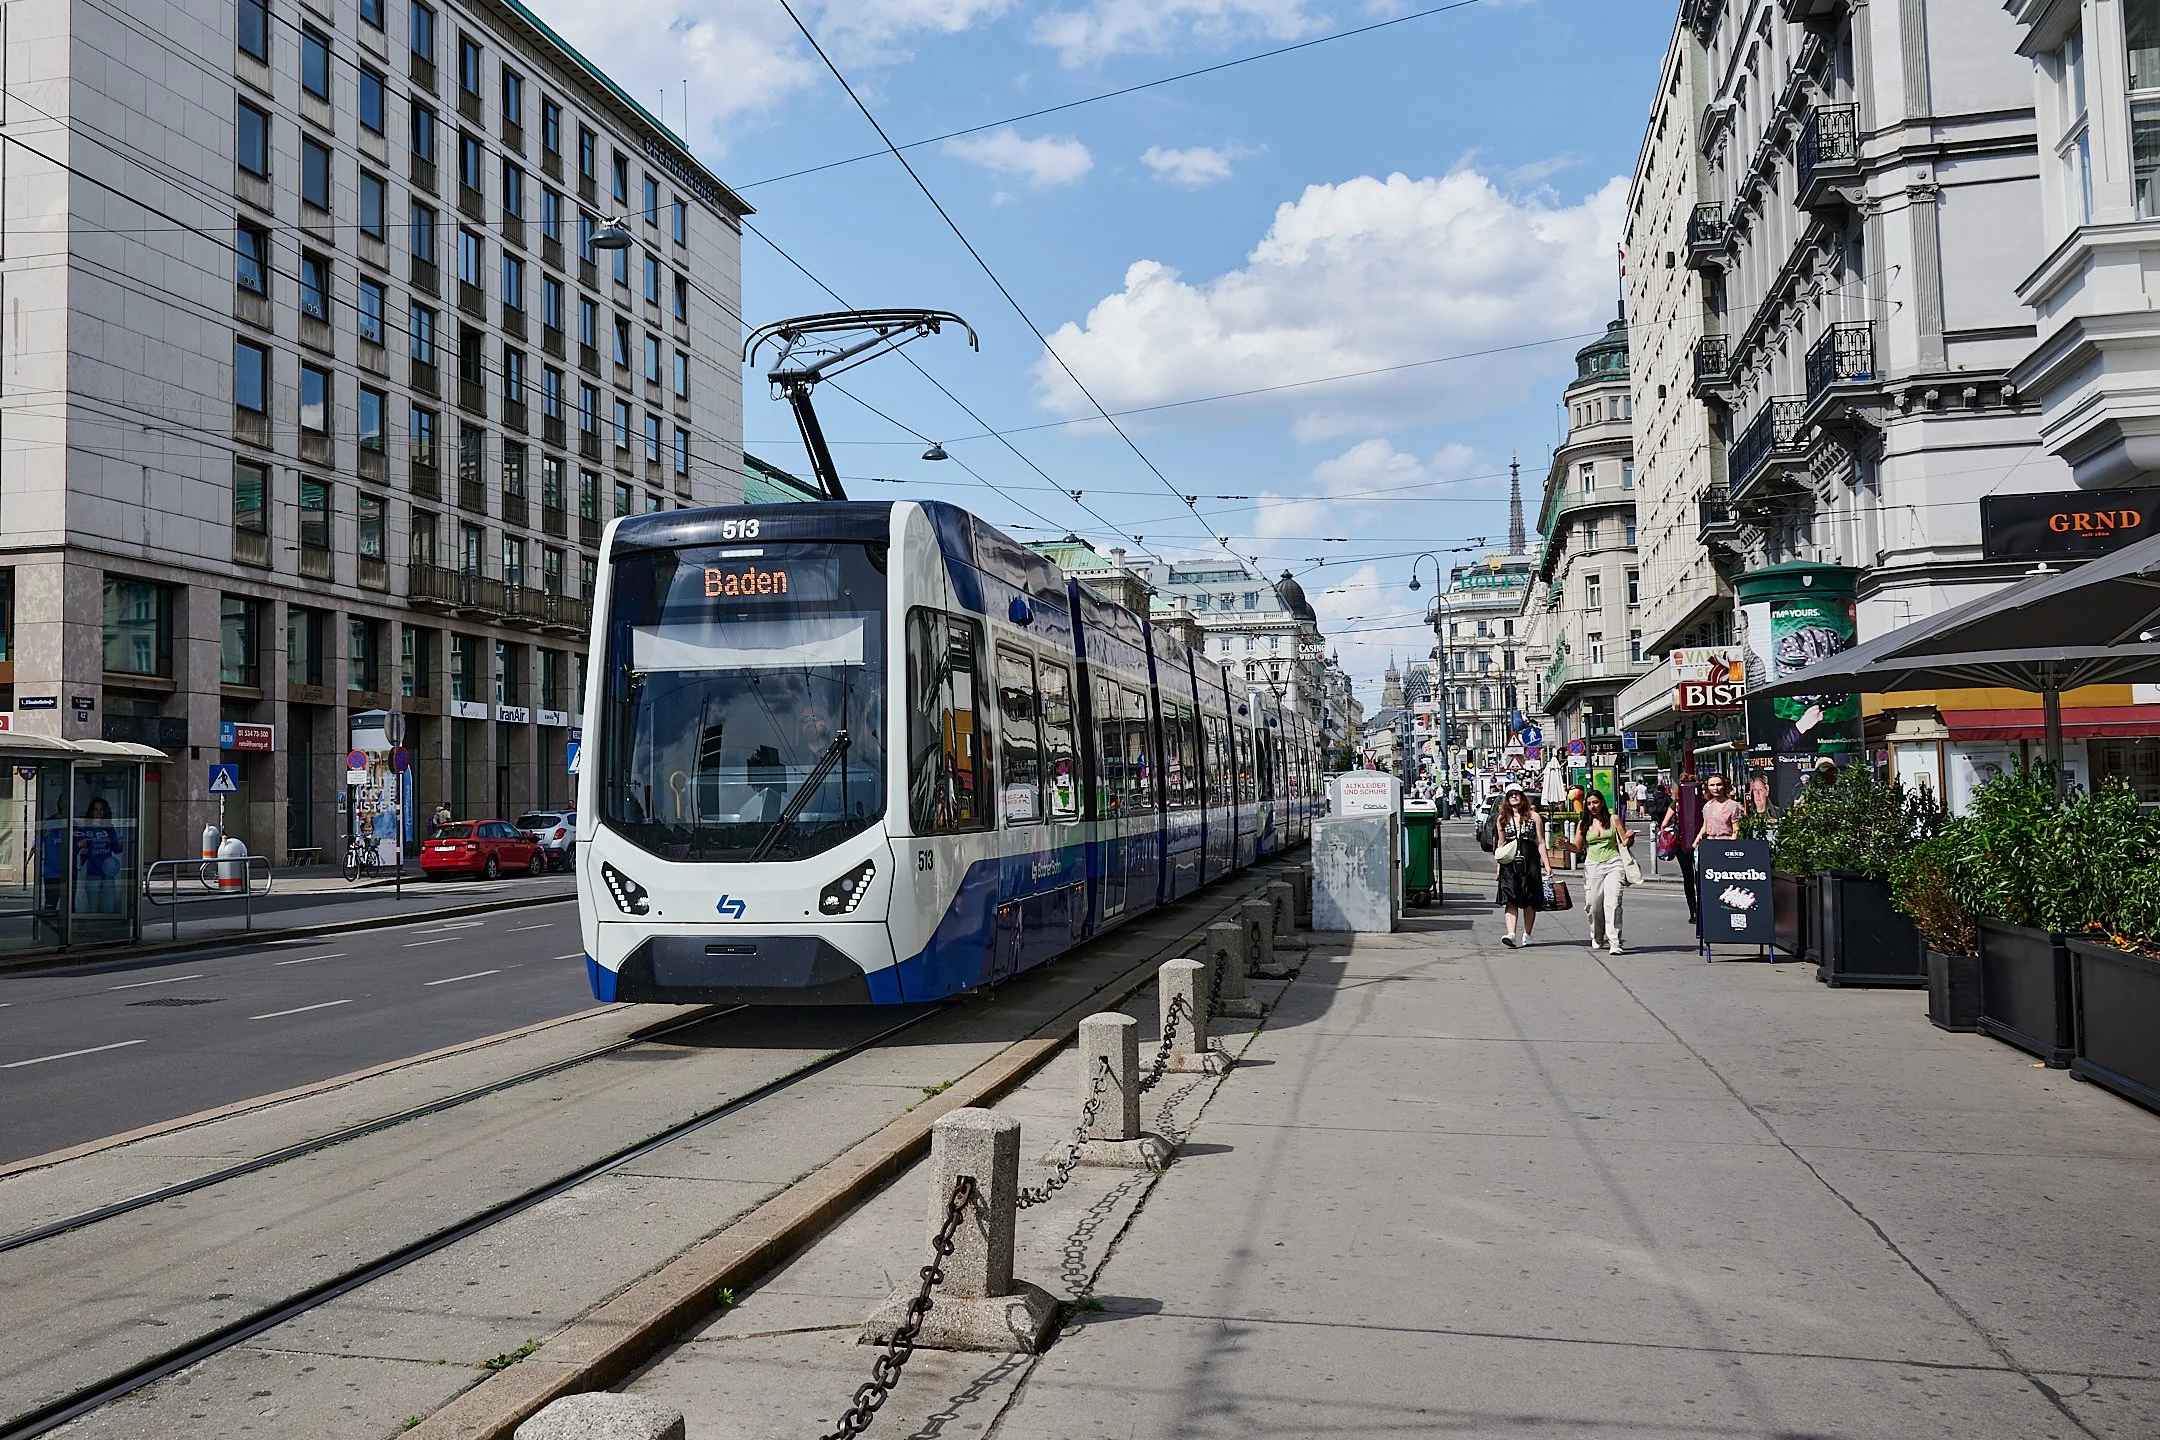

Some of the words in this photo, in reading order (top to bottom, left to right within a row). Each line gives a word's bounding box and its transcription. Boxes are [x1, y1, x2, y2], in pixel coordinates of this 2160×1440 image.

[722, 519, 760, 539] 513
[2049, 510, 2141, 532] GRND
[704, 566, 788, 597] Baden
[1789, 608, 1820, 617] YOURS.
[499, 707, 526, 722] IranAir
[238, 729, 244, 737] 01
[253, 730, 269, 738] 73-500
[918, 850, 934, 871] 513
[1704, 868, 1767, 882] Spareribs
